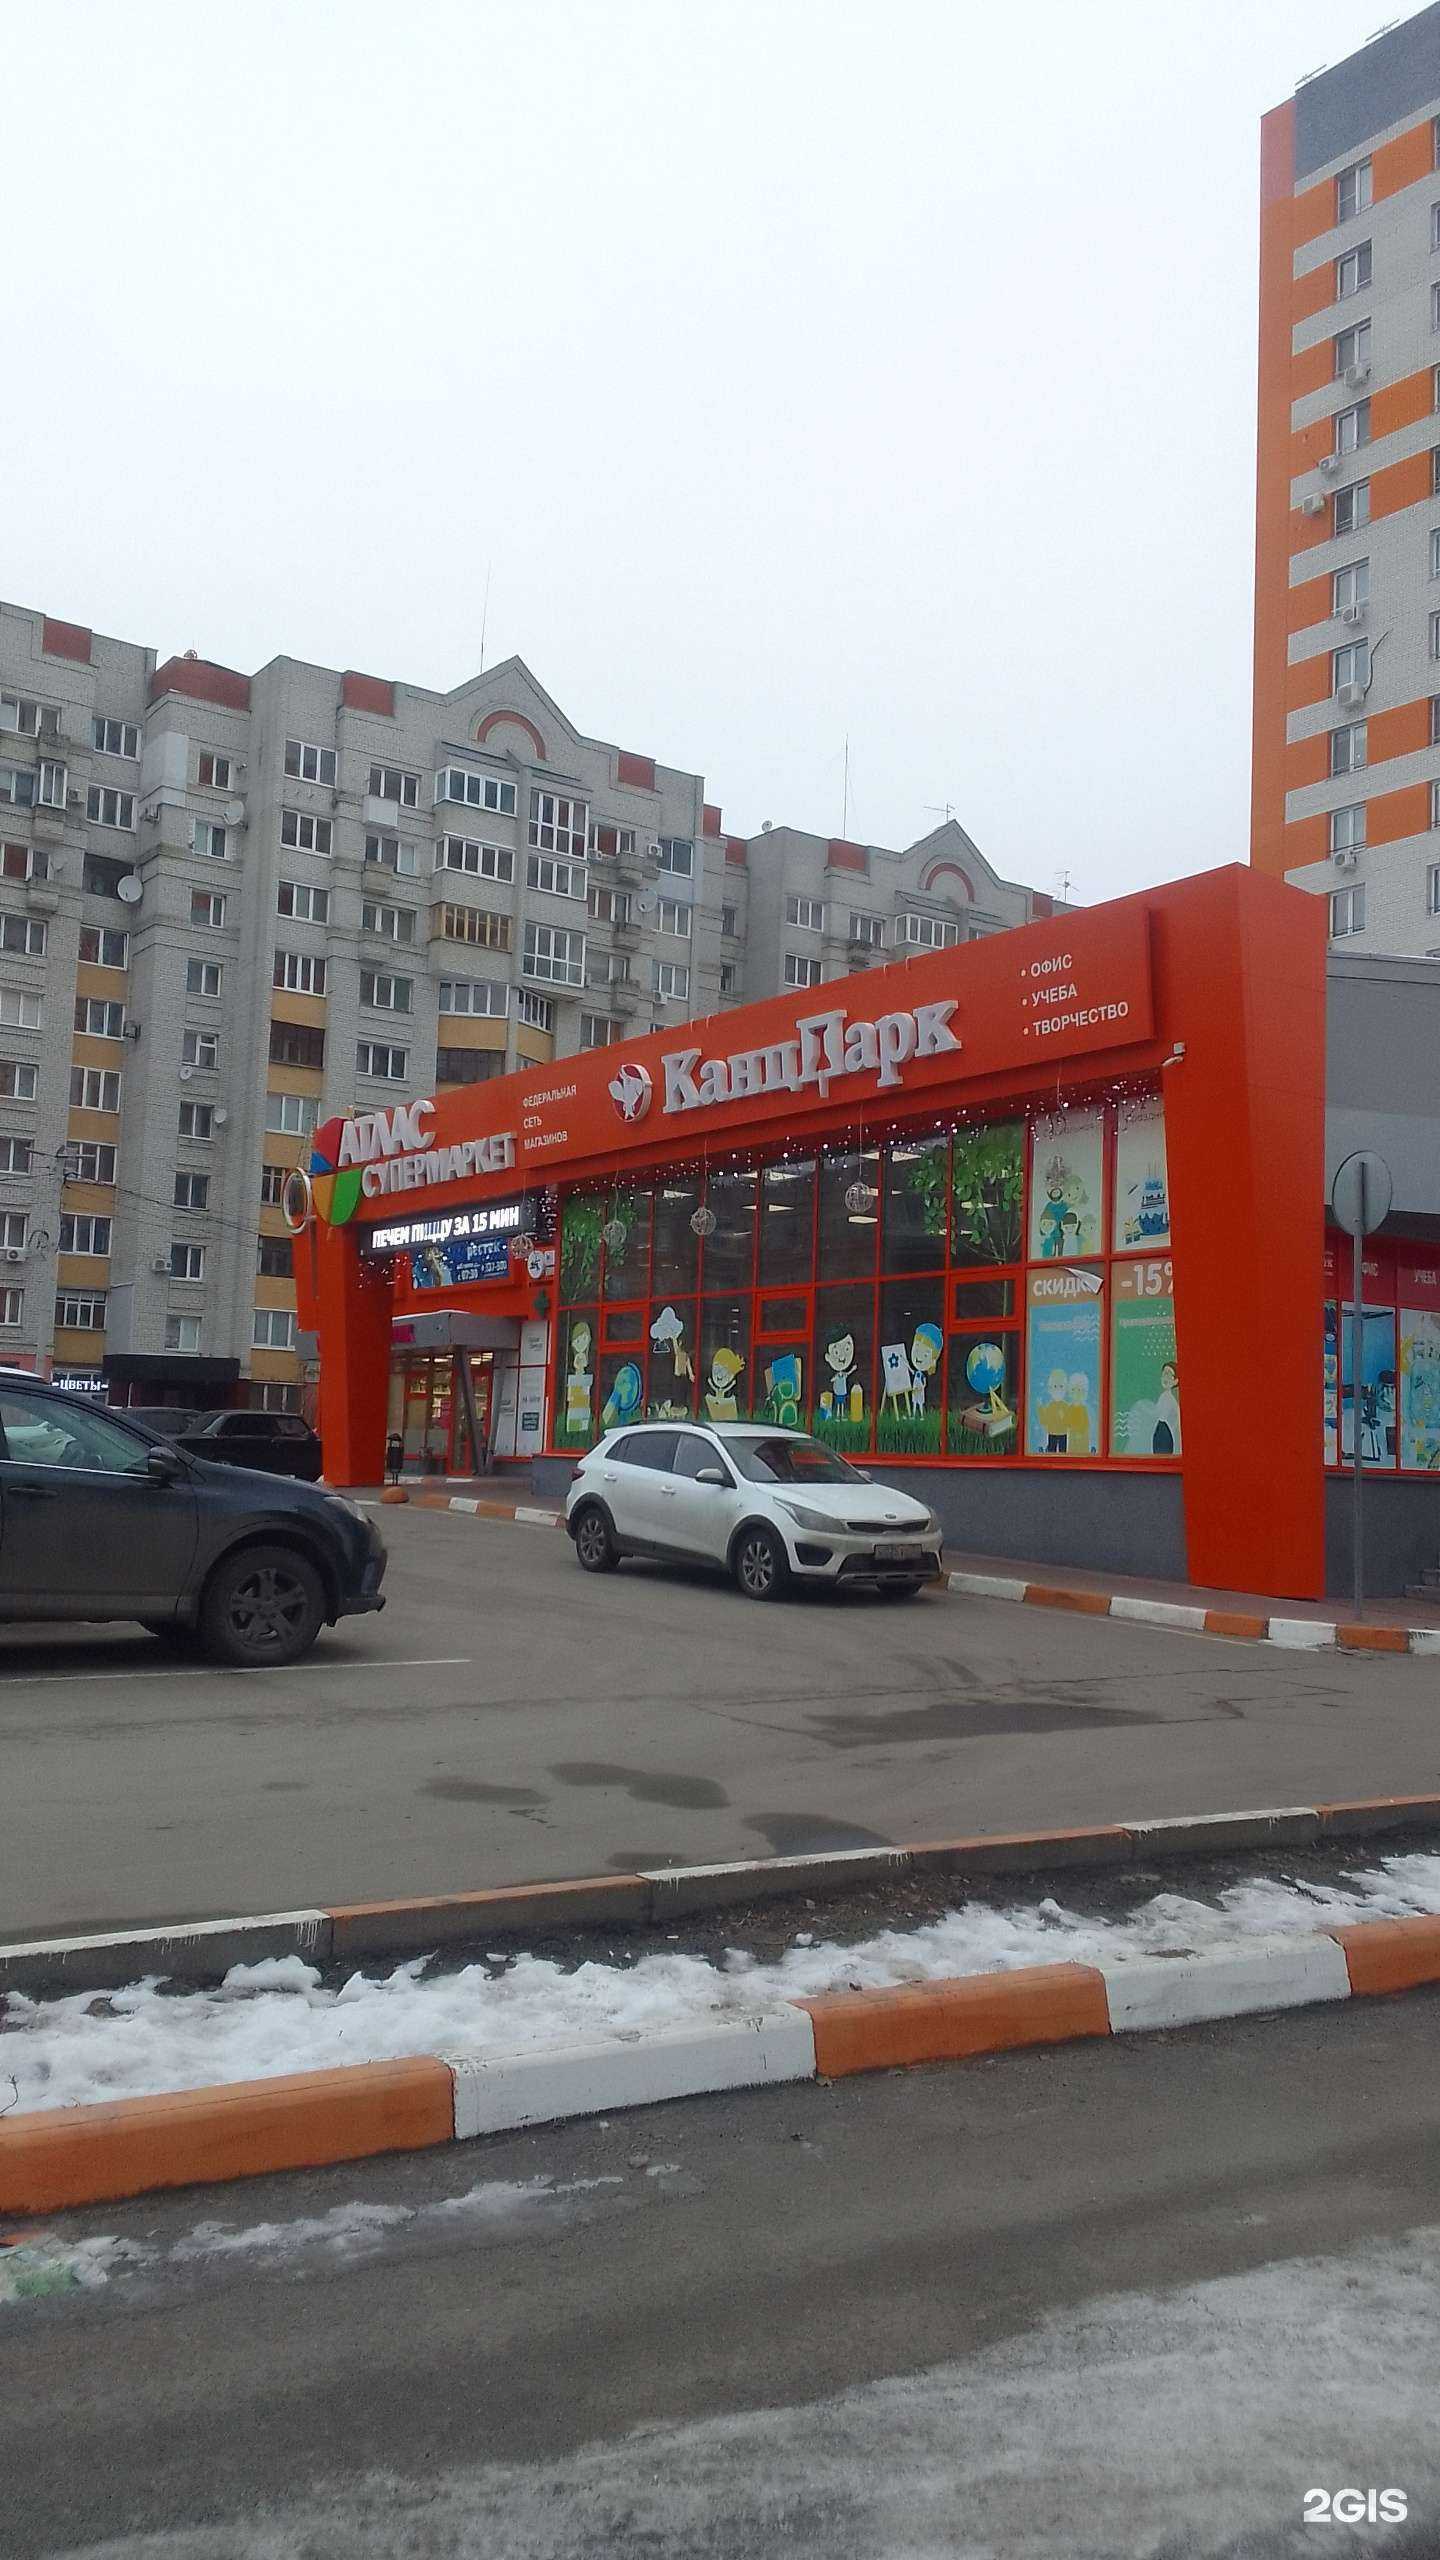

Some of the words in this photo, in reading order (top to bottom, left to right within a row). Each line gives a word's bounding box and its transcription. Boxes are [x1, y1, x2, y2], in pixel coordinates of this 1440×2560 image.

[1030, 954, 1072, 977] ОФИС
[1032, 983, 1078, 1007] УЧЕБА
[1032, 1001, 1128, 1036] ТВОРЧЕСТВО
[660, 1000, 962, 1113] КанцПарк
[523, 1085, 577, 1108] ФЕДЕРАЛЬНАЯ
[337, 1100, 437, 1167] АТЛАС
[523, 1116, 542, 1129] СЕТЬ
[524, 1131, 568, 1150] МАГАЗИНОВ
[361, 1132, 517, 1198] СУПЕРМАРКЕТ
[372, 1226, 411, 1249] ПЕЧЕМ
[453, 1214, 471, 1235] ЗА
[471, 1211, 488, 1233] 15
[489, 1205, 520, 1230] МИН
